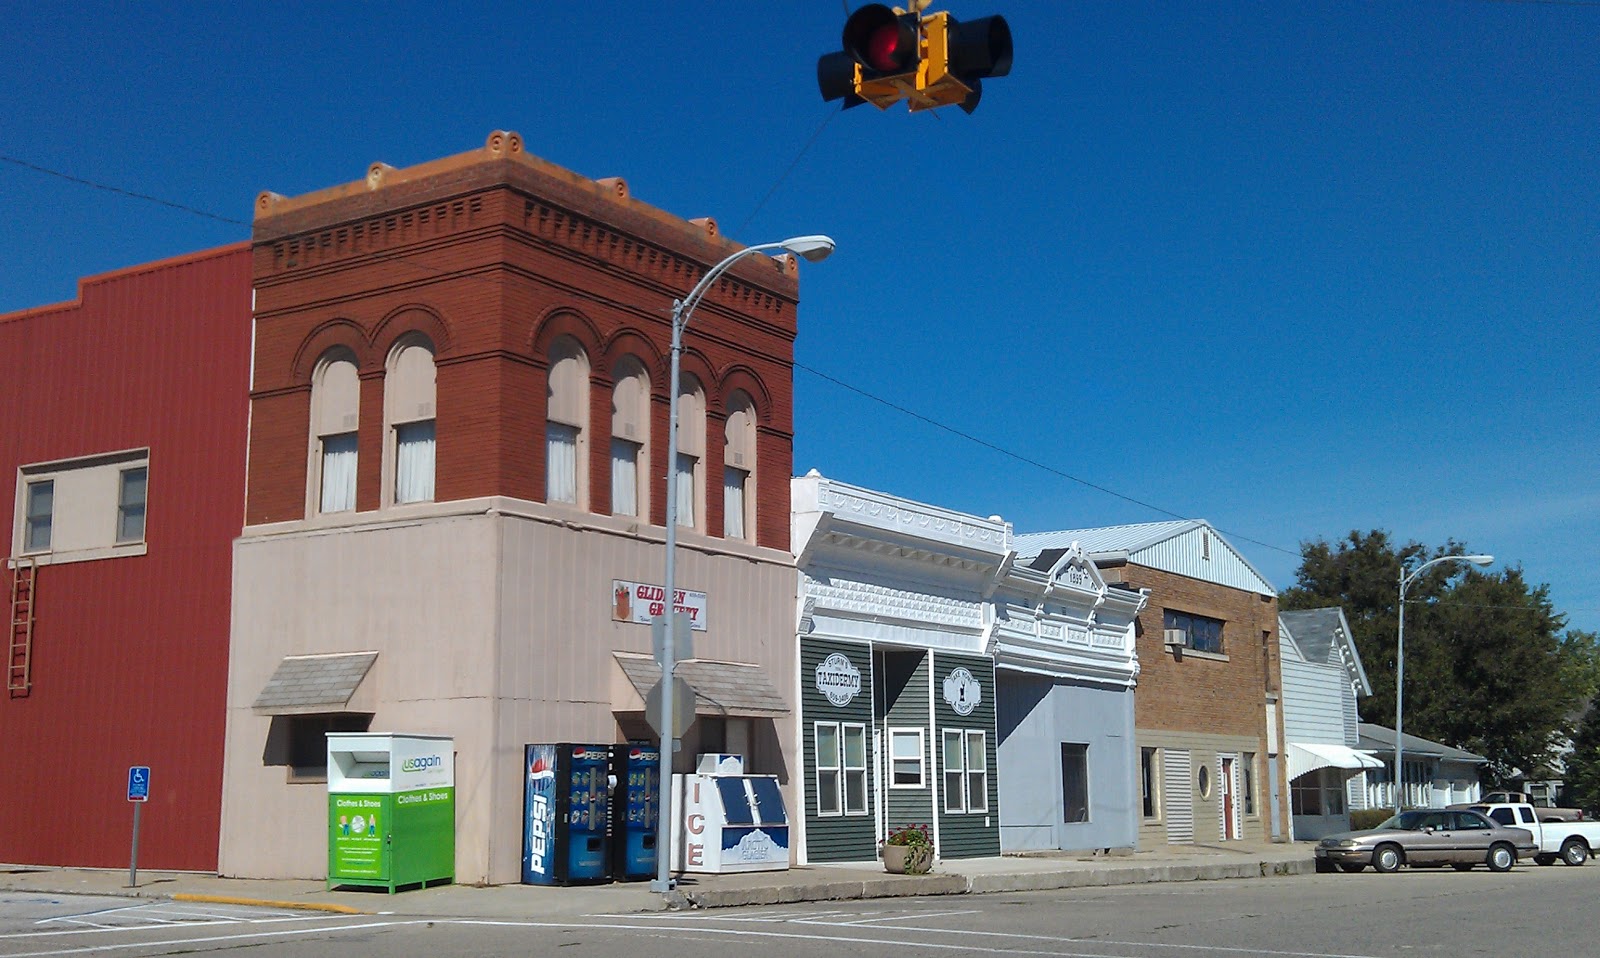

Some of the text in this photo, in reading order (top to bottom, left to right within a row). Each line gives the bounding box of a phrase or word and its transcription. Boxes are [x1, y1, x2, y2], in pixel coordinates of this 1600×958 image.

[637, 585, 686, 605] GLIDEN
[817, 671, 859, 688] TAXIDERMY
[402, 754, 441, 772] usagain
[337, 799, 358, 807] Clothes
[398, 792, 448, 804] Clothes & Shoes
[687, 782, 705, 866] ICE
[531, 794, 547, 875] PEPSI
